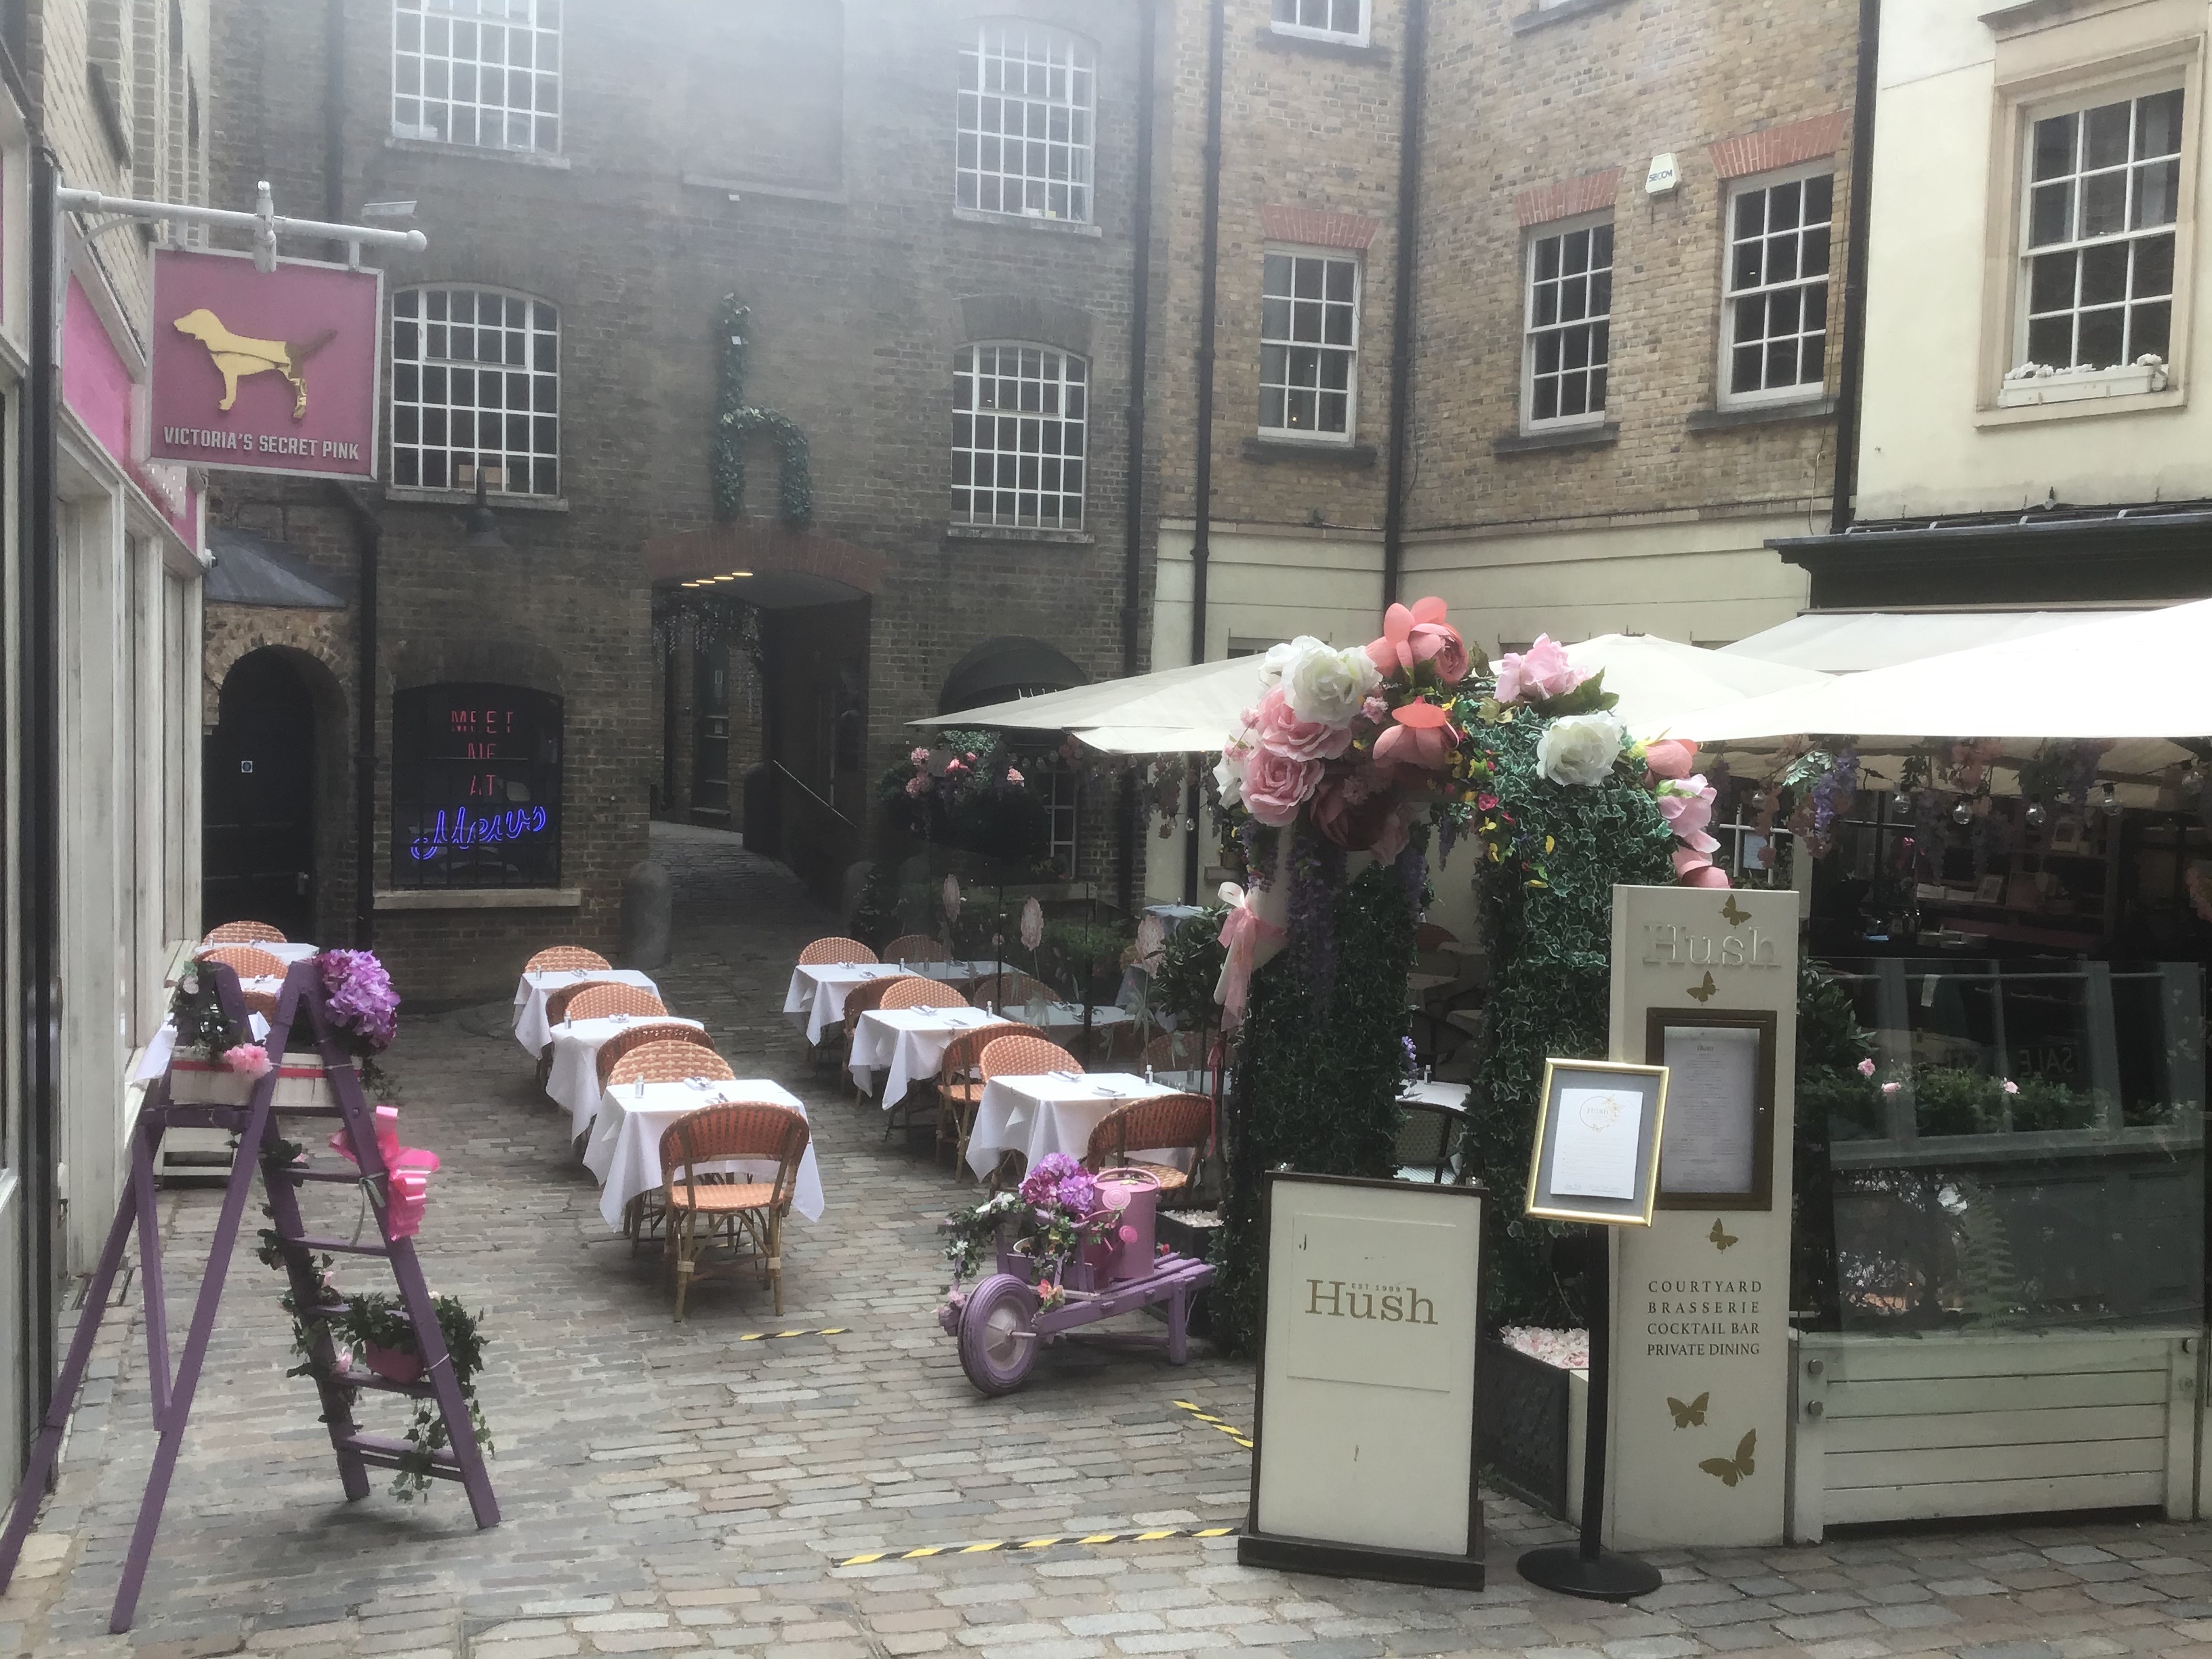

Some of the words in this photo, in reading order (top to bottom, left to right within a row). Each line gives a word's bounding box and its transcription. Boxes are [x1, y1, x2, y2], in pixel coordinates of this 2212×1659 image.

[1649, 169, 1673, 182] SECOM
[163, 426, 253, 451] VICTORIA'S
[259, 434, 318, 457] SECRET
[322, 441, 359, 460] PINK
[450, 710, 514, 733] MEET
[470, 774, 496, 796] AT
[1642, 924, 1782, 968] Hush
[1648, 1281, 1761, 1292] COURTYARD
[1305, 1279, 1438, 1326] Hush
[1648, 1301, 1759, 1314] BRASSERIE
[1647, 1322, 1725, 1334] COCKTAIL
[1731, 1322, 1760, 1334] BAR
[1647, 1343, 1705, 1355] PRIVATE
[1709, 1343, 1760, 1355] DINING
